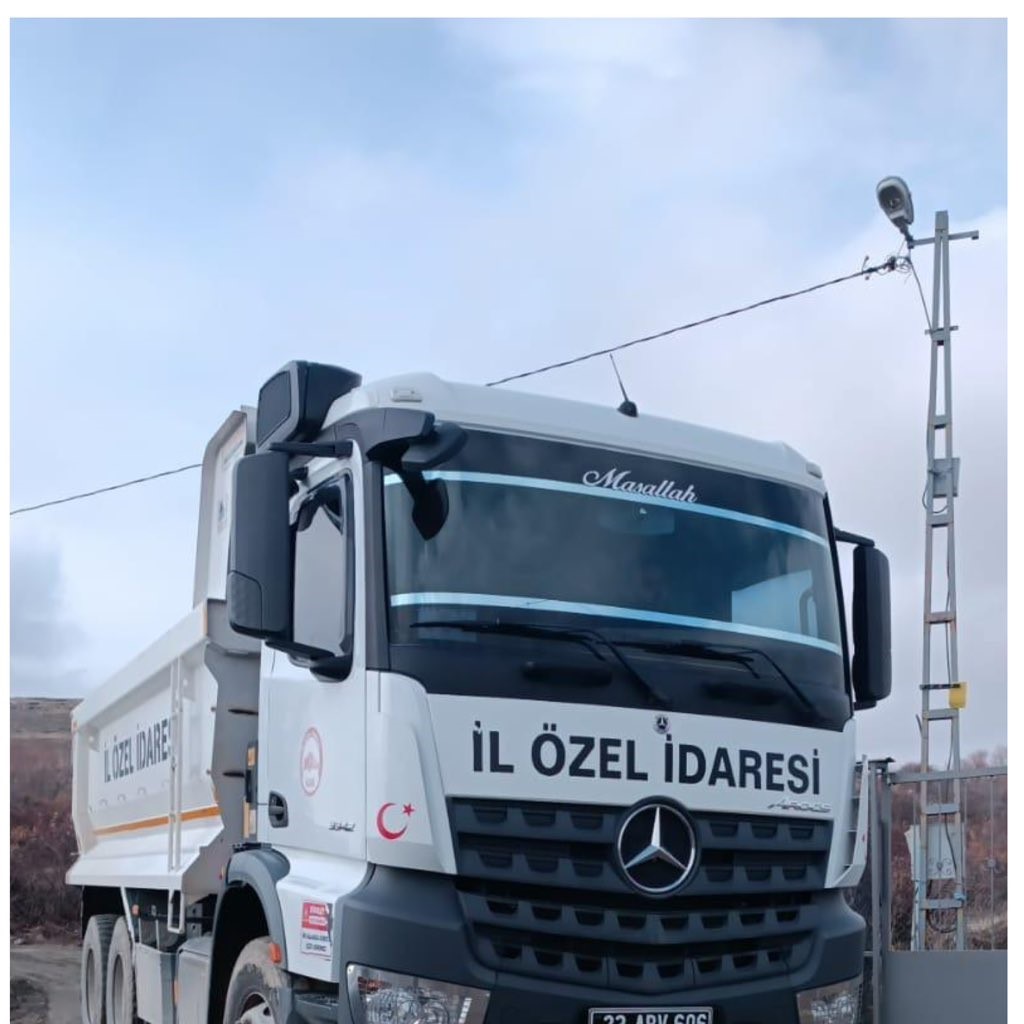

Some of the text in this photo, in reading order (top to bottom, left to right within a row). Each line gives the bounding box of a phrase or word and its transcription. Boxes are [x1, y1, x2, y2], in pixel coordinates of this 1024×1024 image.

[472, 720, 820, 796] İL ÖZEL İDARESİ
